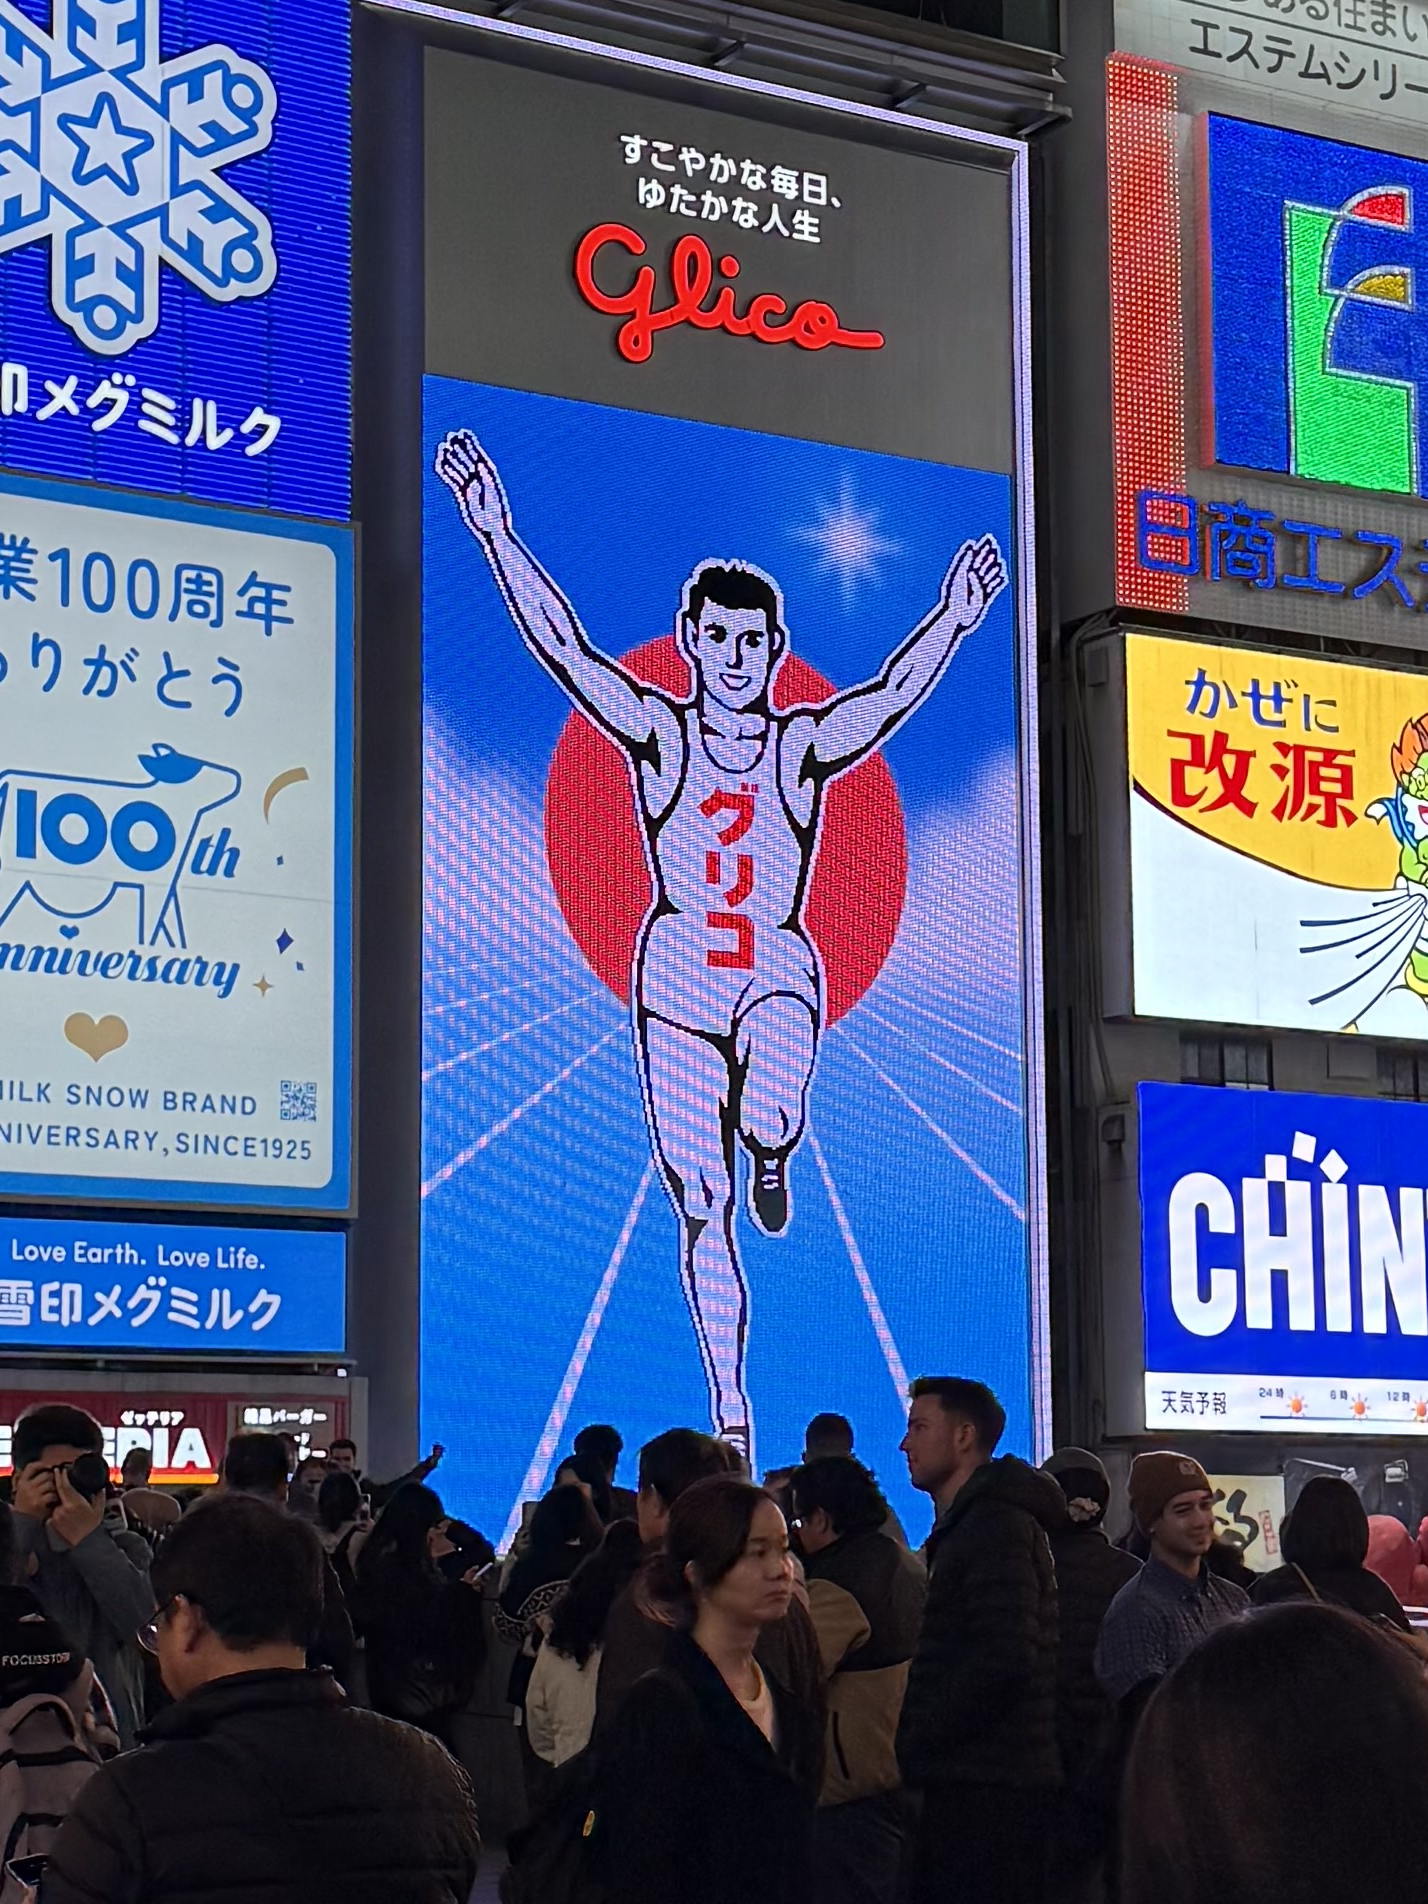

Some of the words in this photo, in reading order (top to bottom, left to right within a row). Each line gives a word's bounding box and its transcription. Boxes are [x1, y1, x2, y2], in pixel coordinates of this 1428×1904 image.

[619, 133, 843, 209] すこやかな毎日、
[637, 176, 821, 244] ゆたかな人生
[573, 222, 886, 363] Glico
[1184, 667, 1340, 734] かぜに
[1166, 728, 1359, 829] 改源
[699, 781, 760, 971] グリコ
[66, 1083, 150, 1111] SNOW
[162, 1090, 258, 1118] BRAND
[11, 1238, 66, 1264] Love
[73, 1240, 147, 1267] Earth.
[157, 1243, 211, 1269] Love
[216, 1246, 267, 1272] Life.
[1161, 1389, 1228, 1416] 天気予報
